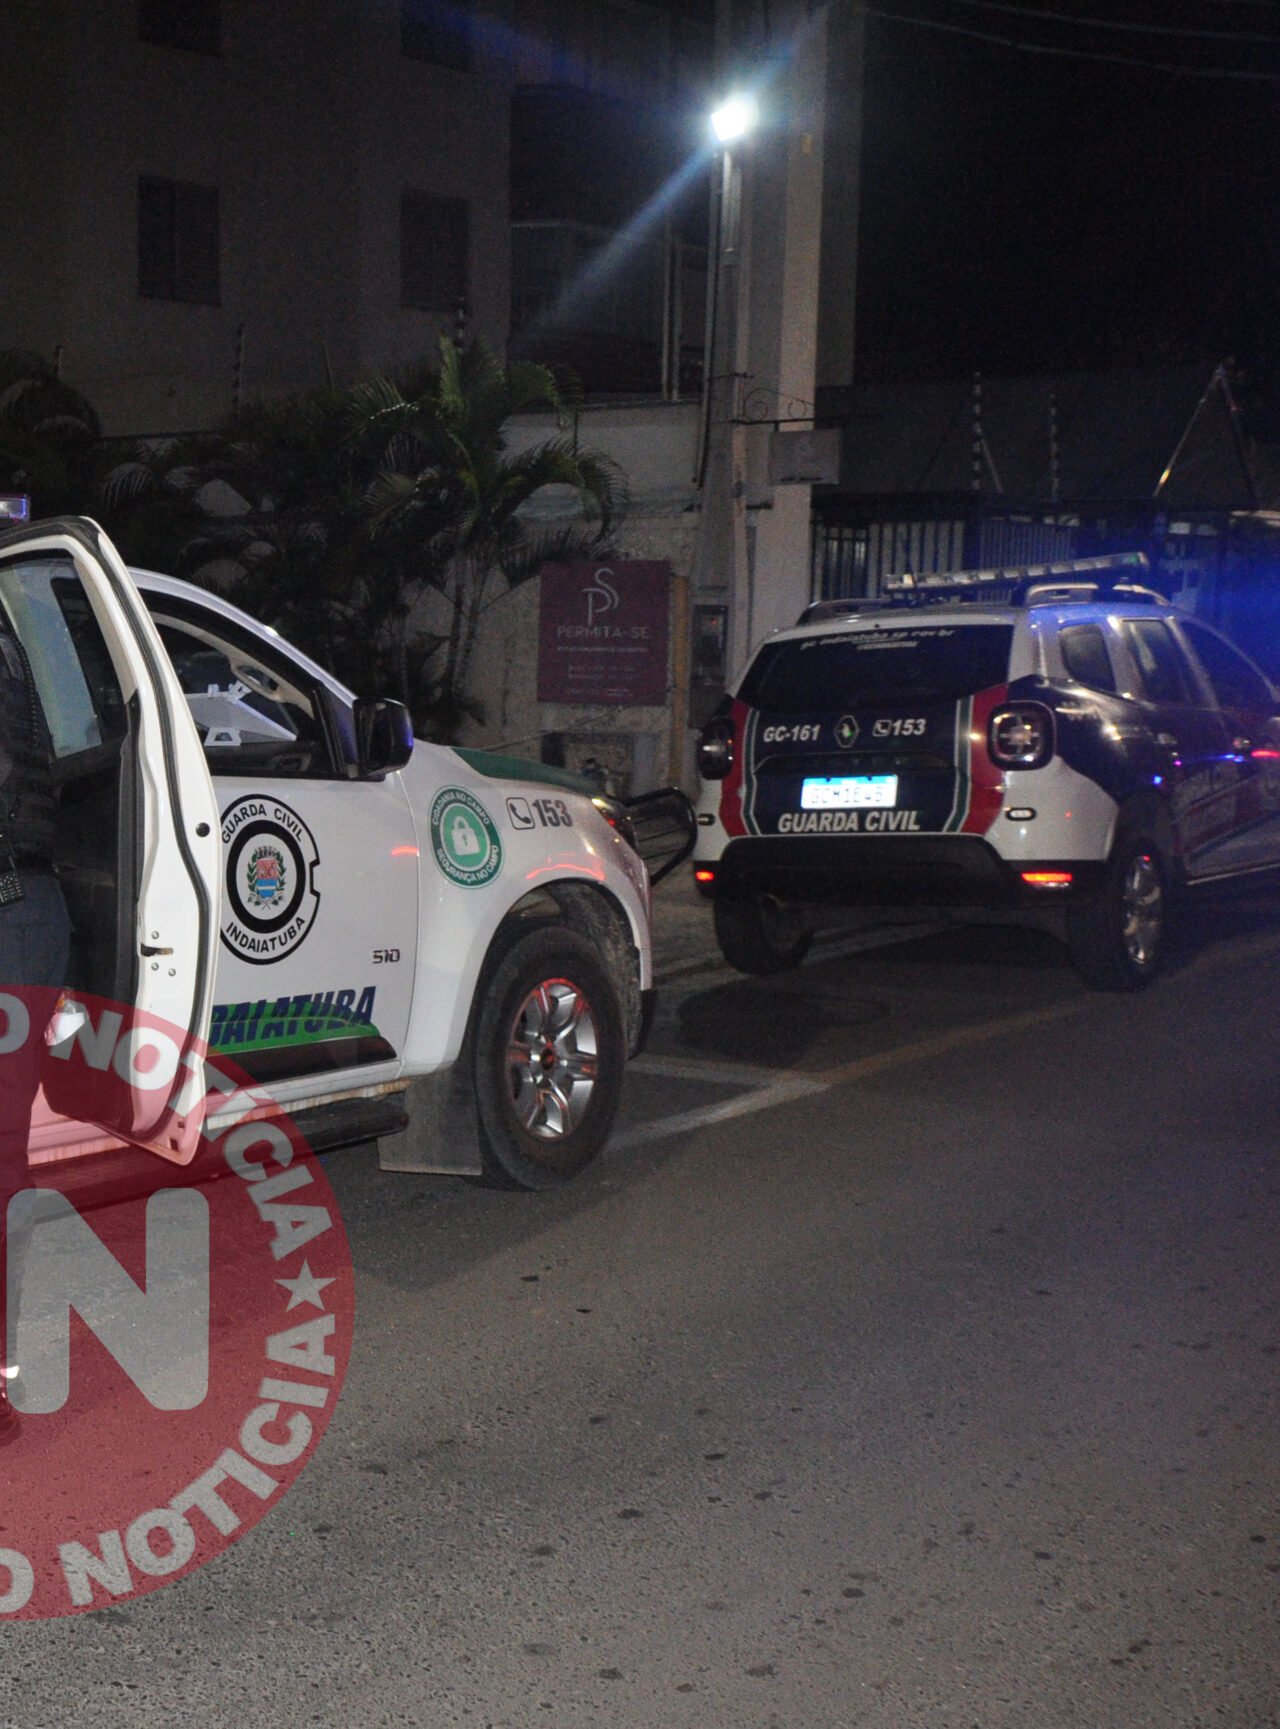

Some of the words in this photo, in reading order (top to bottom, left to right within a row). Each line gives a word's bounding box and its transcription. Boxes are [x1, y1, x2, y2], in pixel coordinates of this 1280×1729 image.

[763, 724, 821, 742] GC-161
[891, 718, 926, 736] 153
[221, 803, 267, 844] GUARDA
[274, 808, 304, 843] CIVIL
[532, 799, 573, 827] 153
[777, 813, 859, 833] GUARDA
[865, 811, 921, 831] CIVIL
[226, 916, 305, 953] INDAIATUBA
[209, 985, 377, 1047] DAIATUBA
